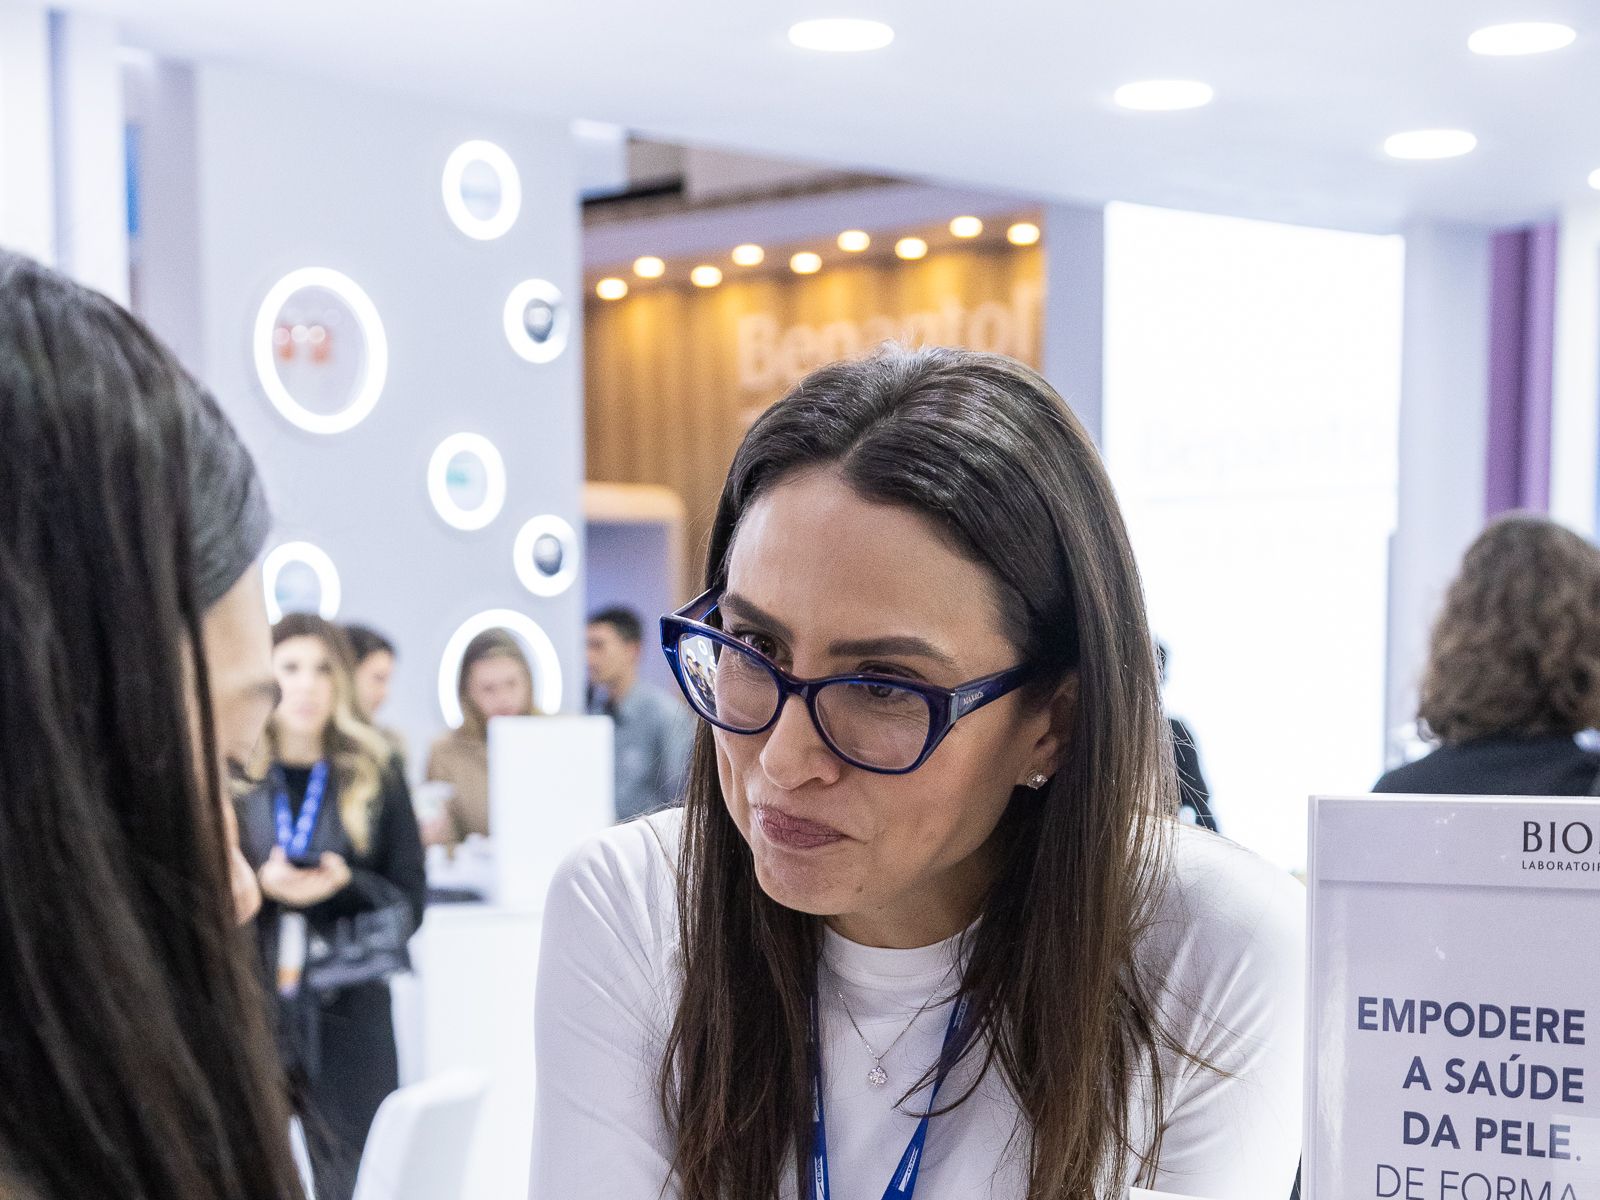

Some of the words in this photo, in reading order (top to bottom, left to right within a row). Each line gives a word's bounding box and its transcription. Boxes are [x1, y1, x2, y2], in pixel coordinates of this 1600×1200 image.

[1522, 820, 1600, 855] BIO
[1357, 997, 1585, 1045] EMPODERE
[1403, 1056, 1431, 1091] A
[1445, 1054, 1584, 1103] SAÚDE
[1403, 1111, 1461, 1150] DA
[1475, 1117, 1582, 1162] PELE.
